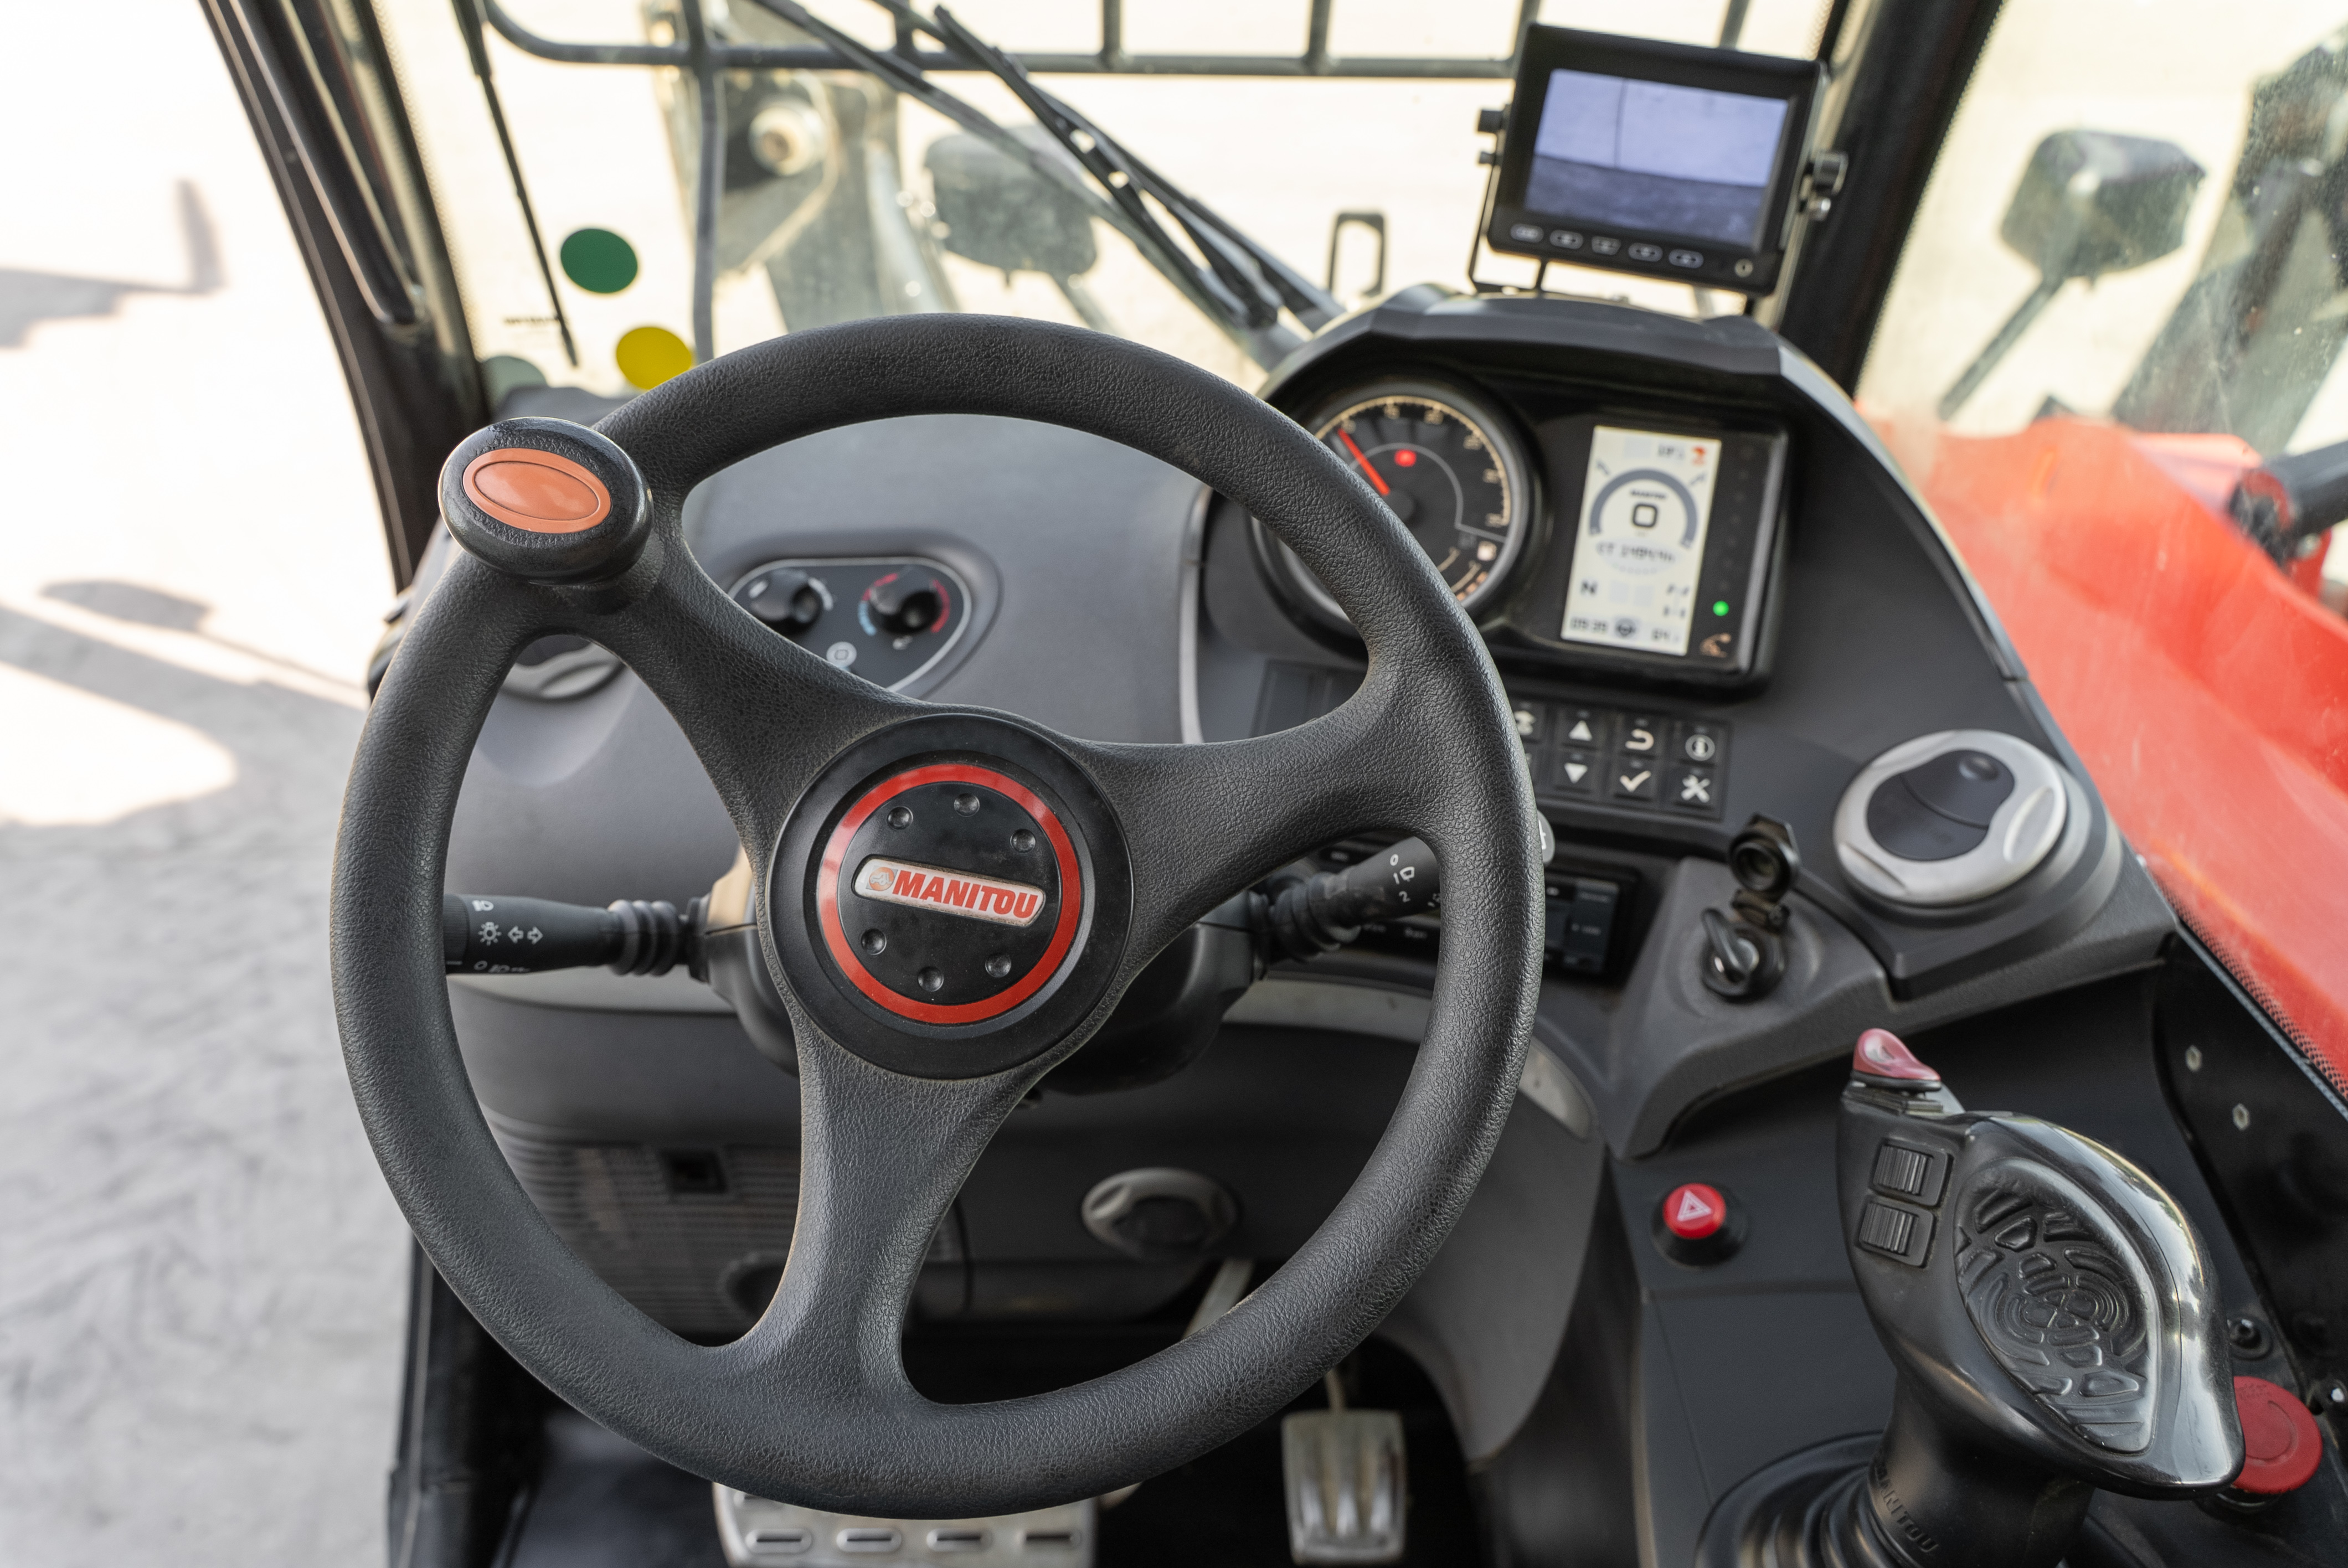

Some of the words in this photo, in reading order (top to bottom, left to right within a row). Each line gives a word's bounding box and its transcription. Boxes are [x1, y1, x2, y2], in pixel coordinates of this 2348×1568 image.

[1390, 854, 1399, 866] 0
[892, 870, 1038, 919] MANITOU
[1399, 891, 1411, 902] 2
